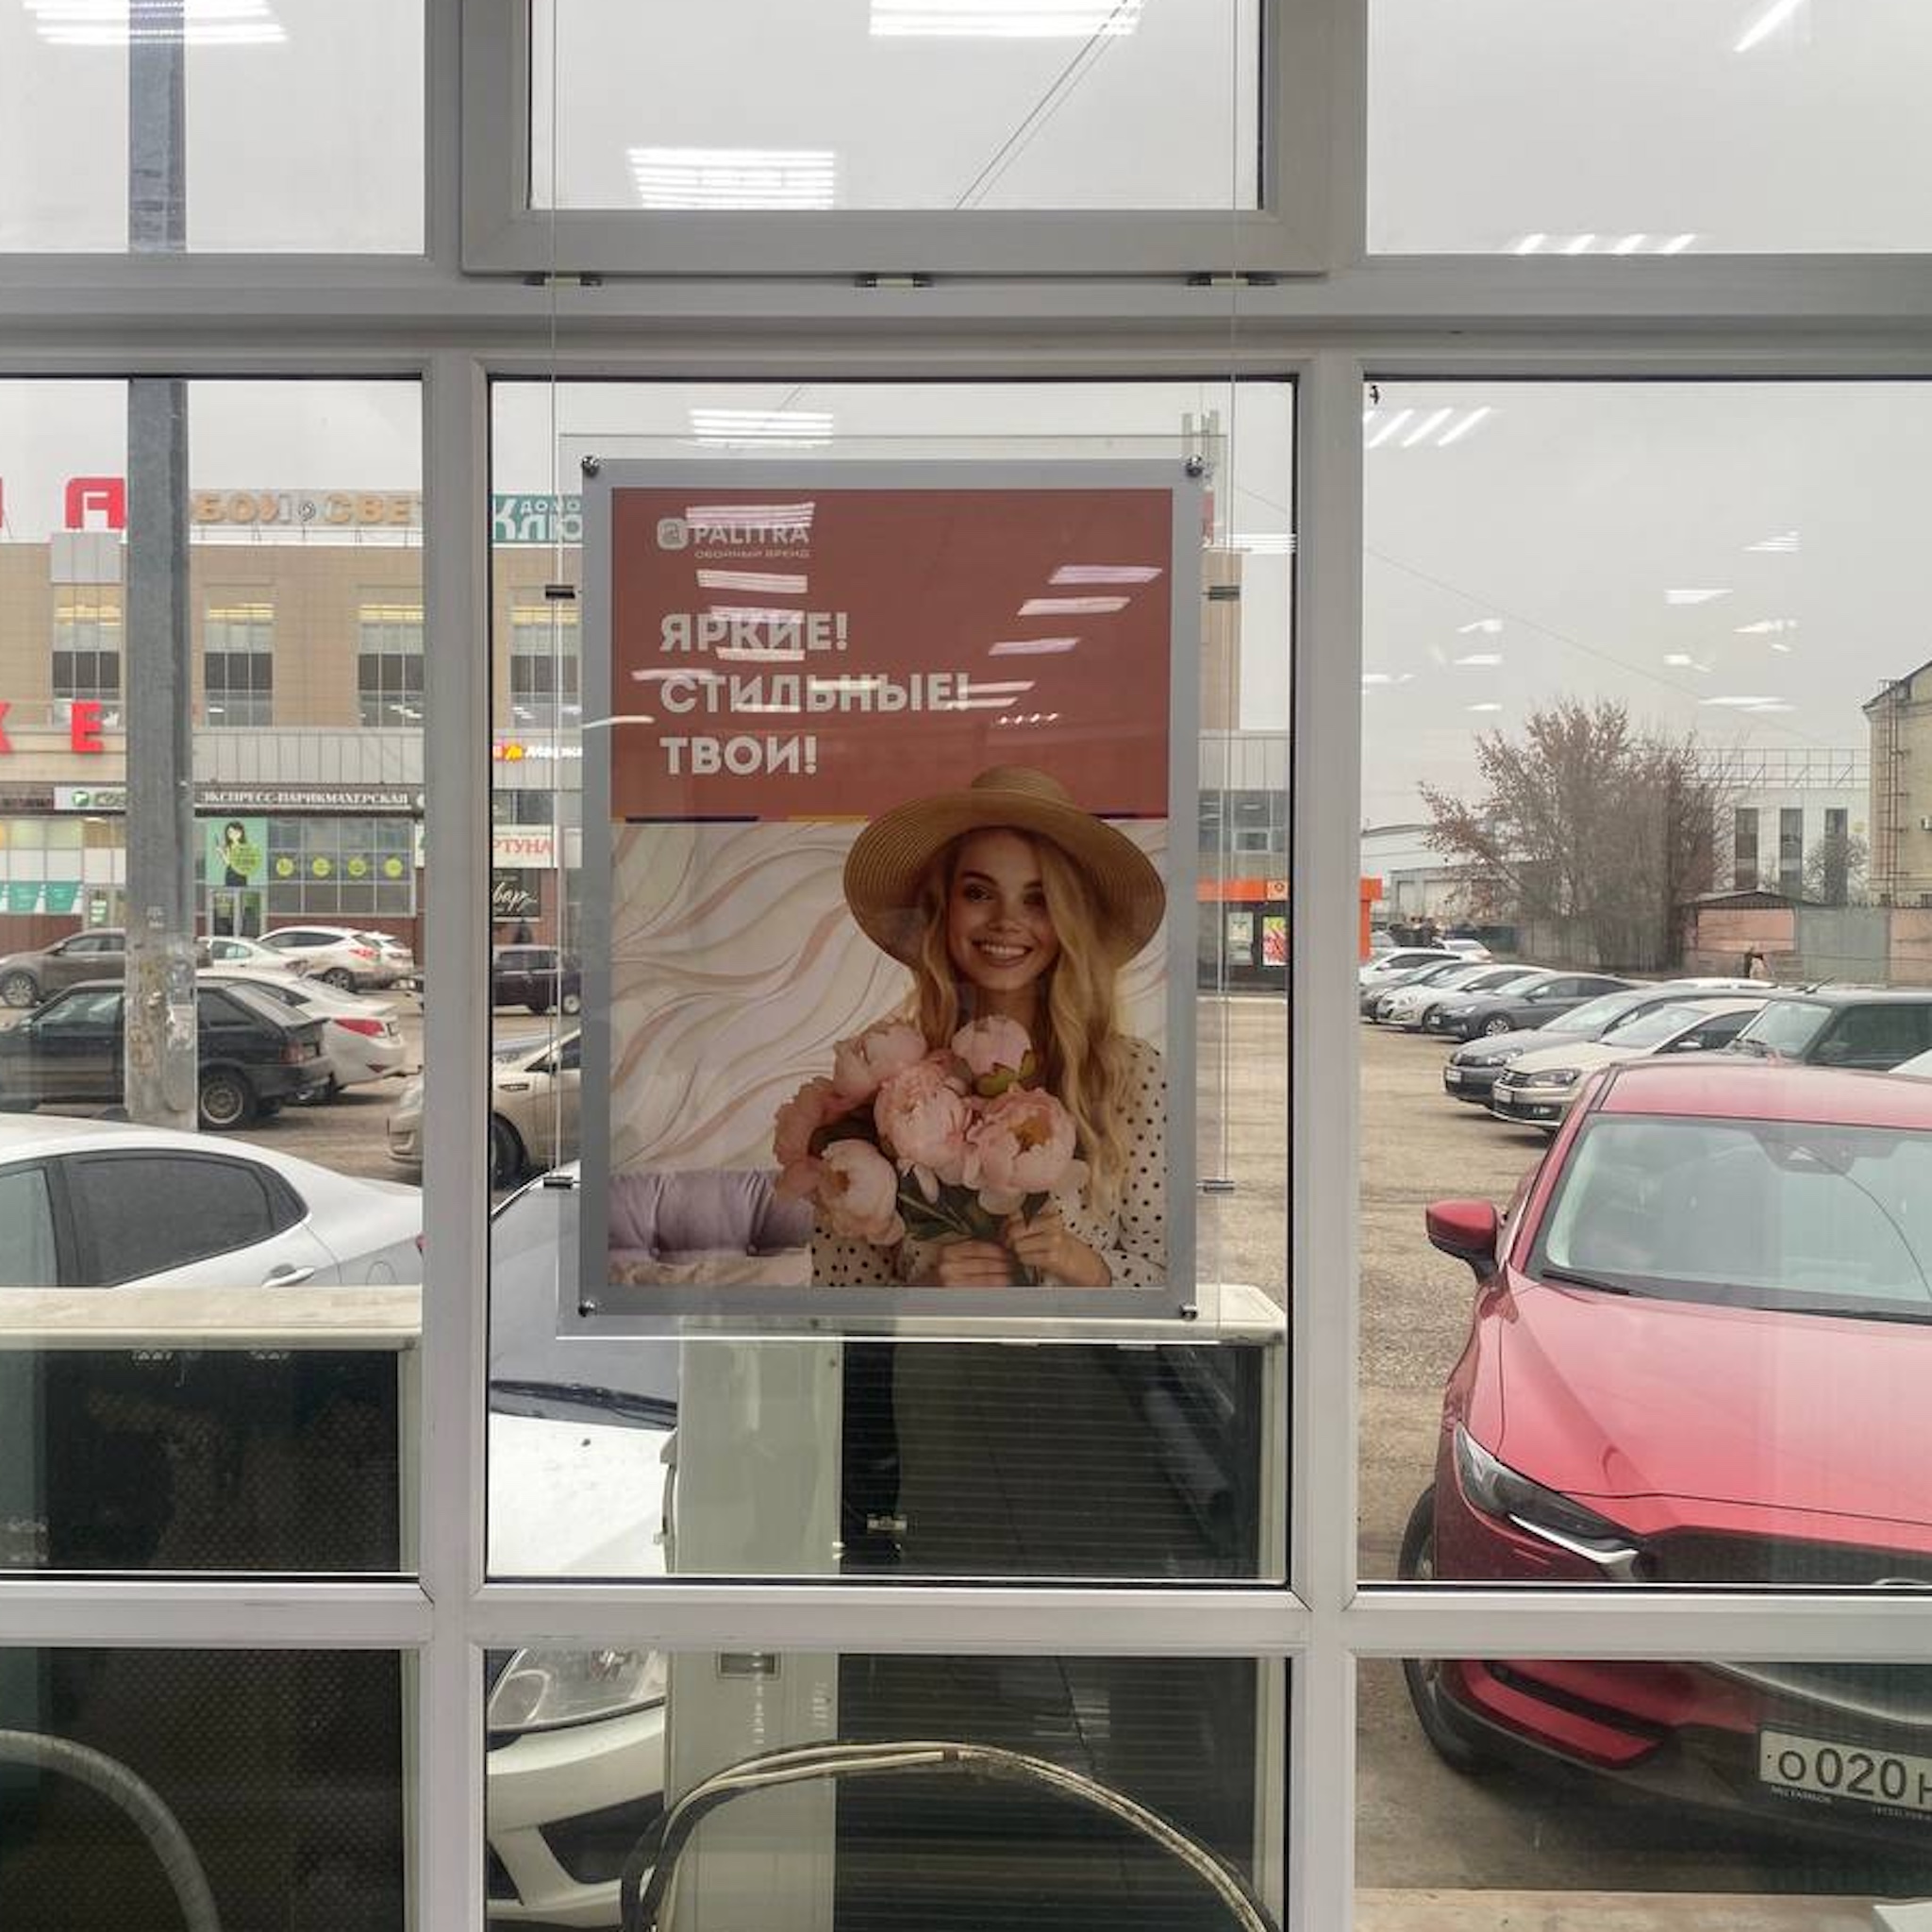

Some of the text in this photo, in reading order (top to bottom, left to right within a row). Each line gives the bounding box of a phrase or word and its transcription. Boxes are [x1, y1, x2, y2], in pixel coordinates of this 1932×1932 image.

[694, 523, 810, 544] PALITRA
[659, 612, 847, 652] ЯРКИЕ!
[660, 673, 969, 713] СТИЛЬНЫЕ!
[659, 736, 817, 774] ТВОИ!
